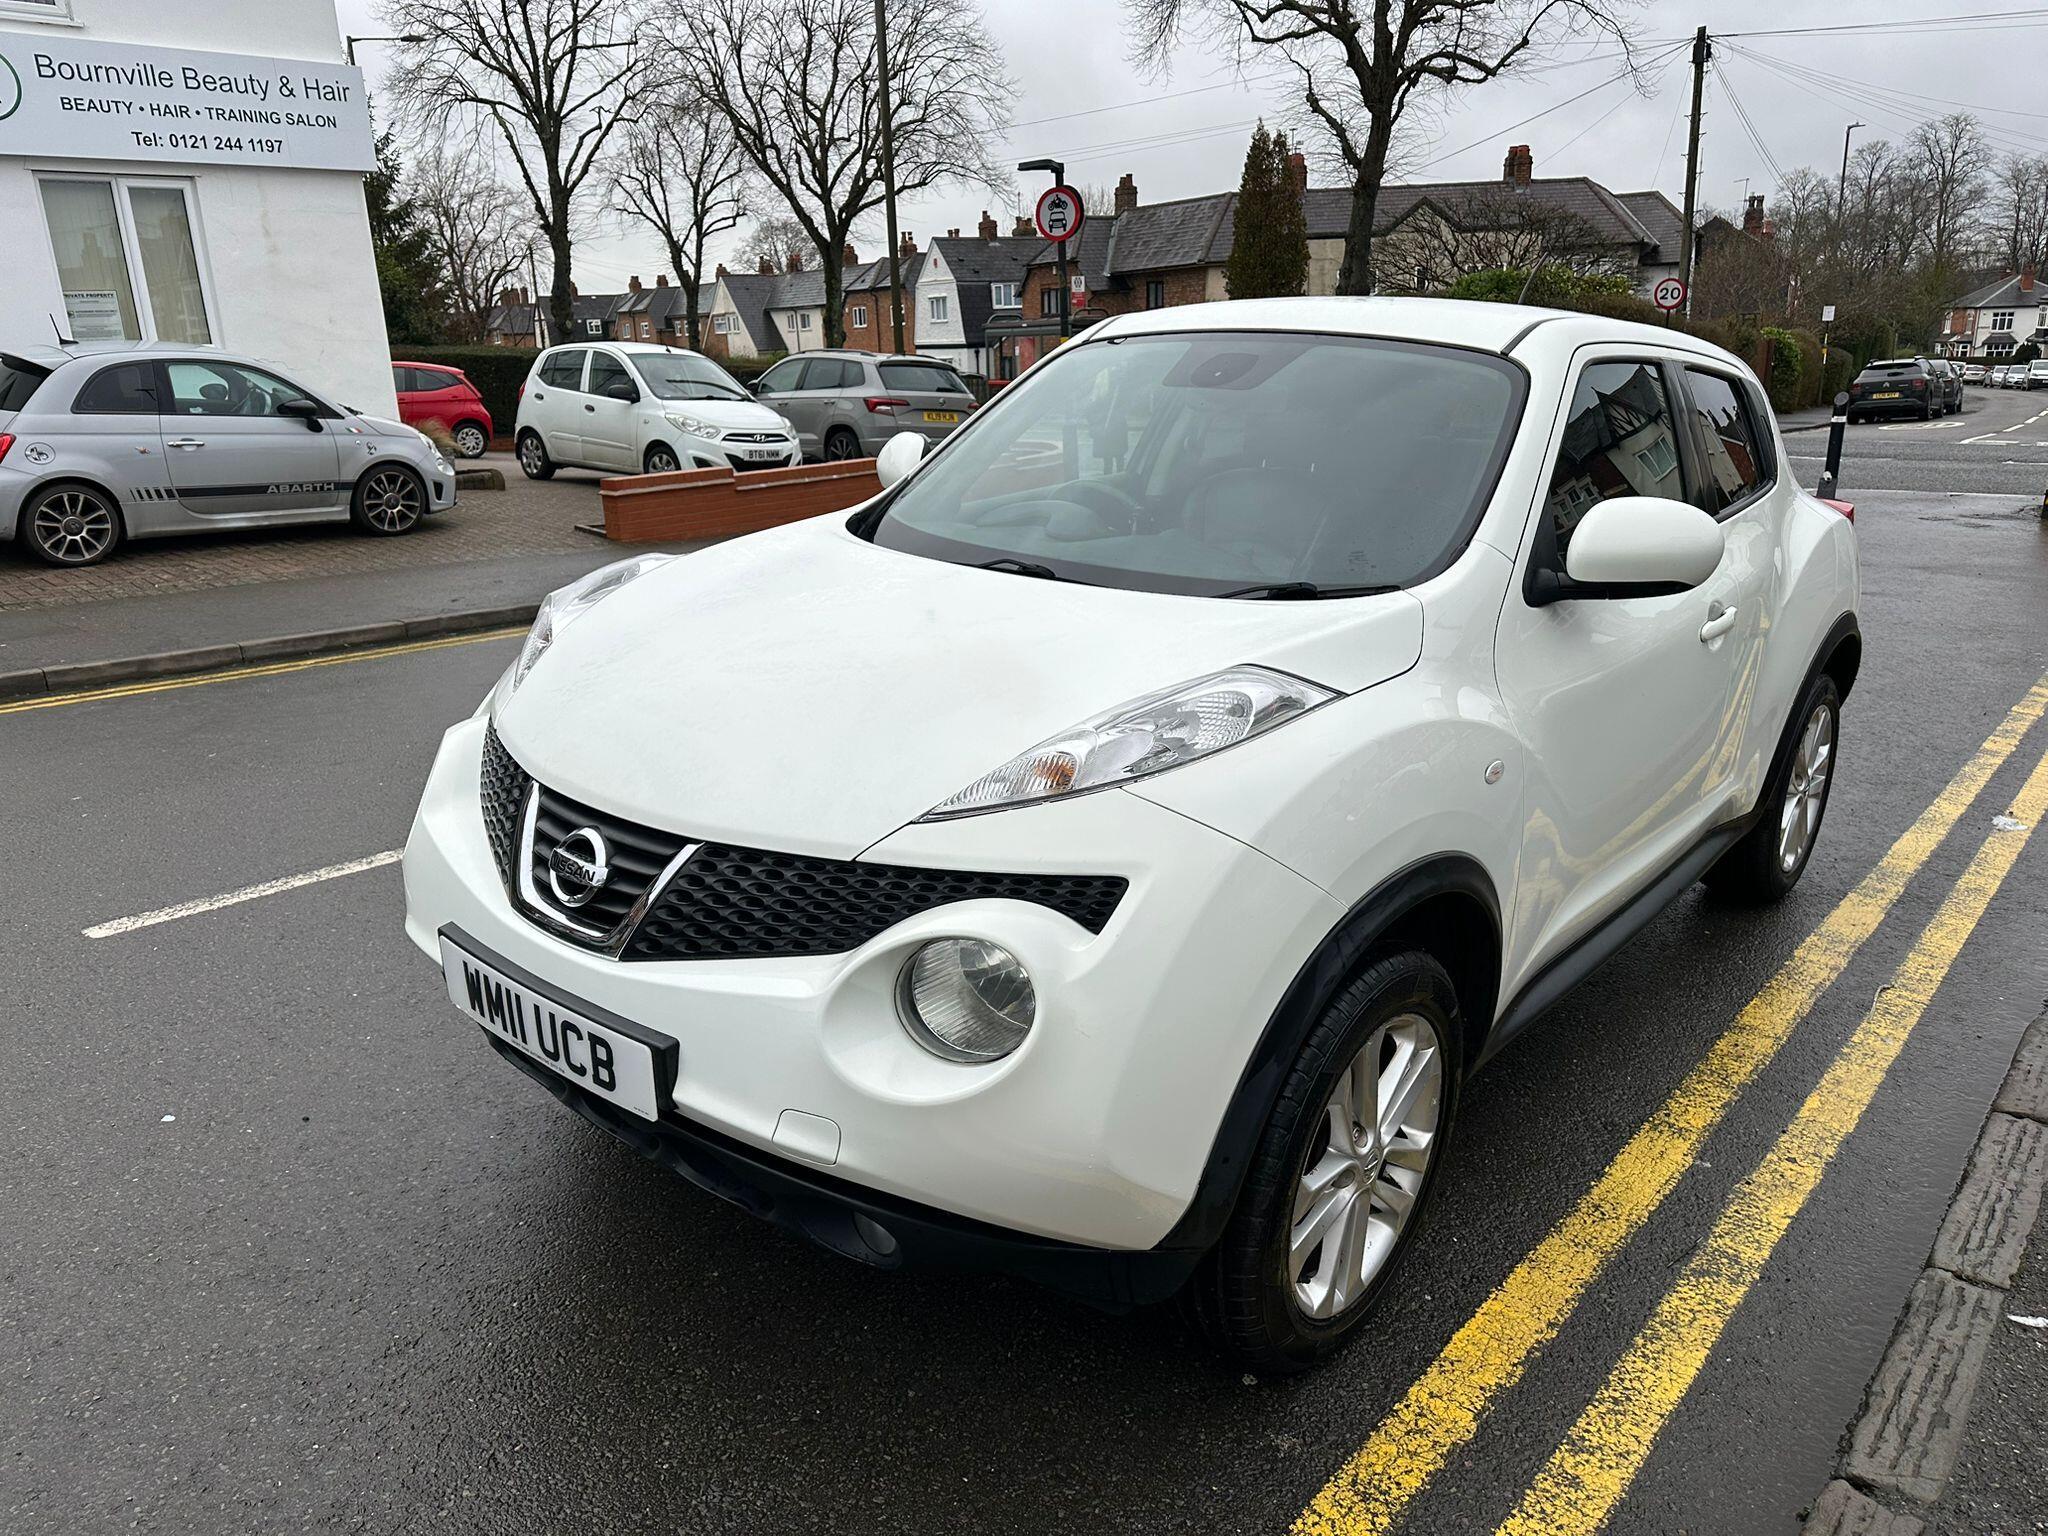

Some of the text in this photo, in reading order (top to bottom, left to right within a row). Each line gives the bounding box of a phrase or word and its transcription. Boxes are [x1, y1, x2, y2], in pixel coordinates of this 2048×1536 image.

[34, 54, 350, 102] Bournville Beauty & Hair
[60, 96, 337, 128] BEAUTY HAIR TRAINING SALON
[131, 131, 283, 153] Tel: 0121 244 1197
[1659, 287, 1681, 300] 20
[748, 450, 765, 459] BT61
[267, 482, 335, 494] ABARTH
[463, 960, 527, 1045] WM11
[533, 1003, 616, 1092] UCB
